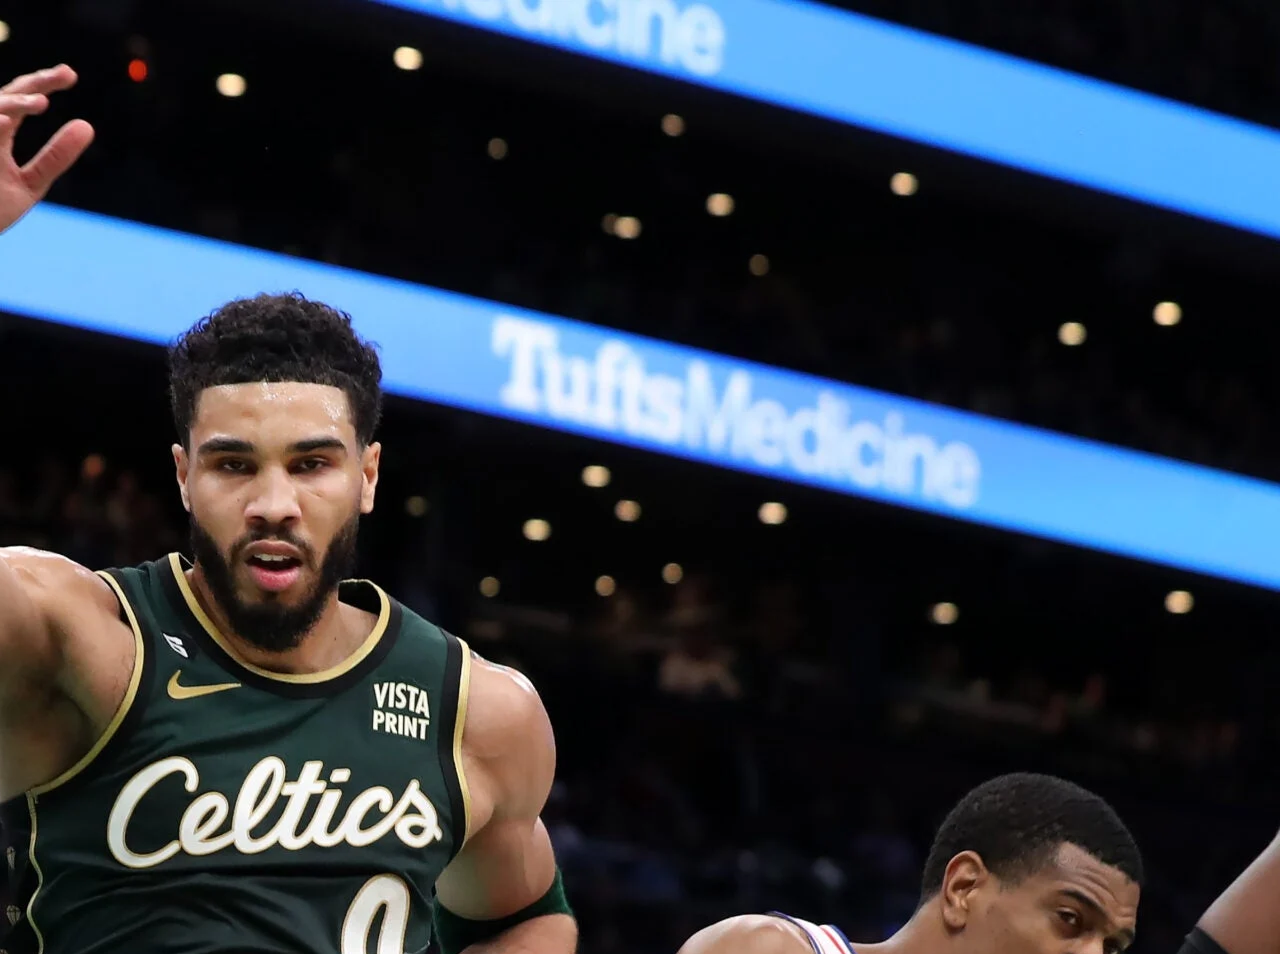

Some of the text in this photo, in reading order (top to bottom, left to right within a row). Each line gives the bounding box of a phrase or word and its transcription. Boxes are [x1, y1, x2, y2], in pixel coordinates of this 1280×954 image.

[373, 682, 430, 718] VISTA
[372, 711, 429, 740] PRINT
[107, 756, 441, 868] Celtics
